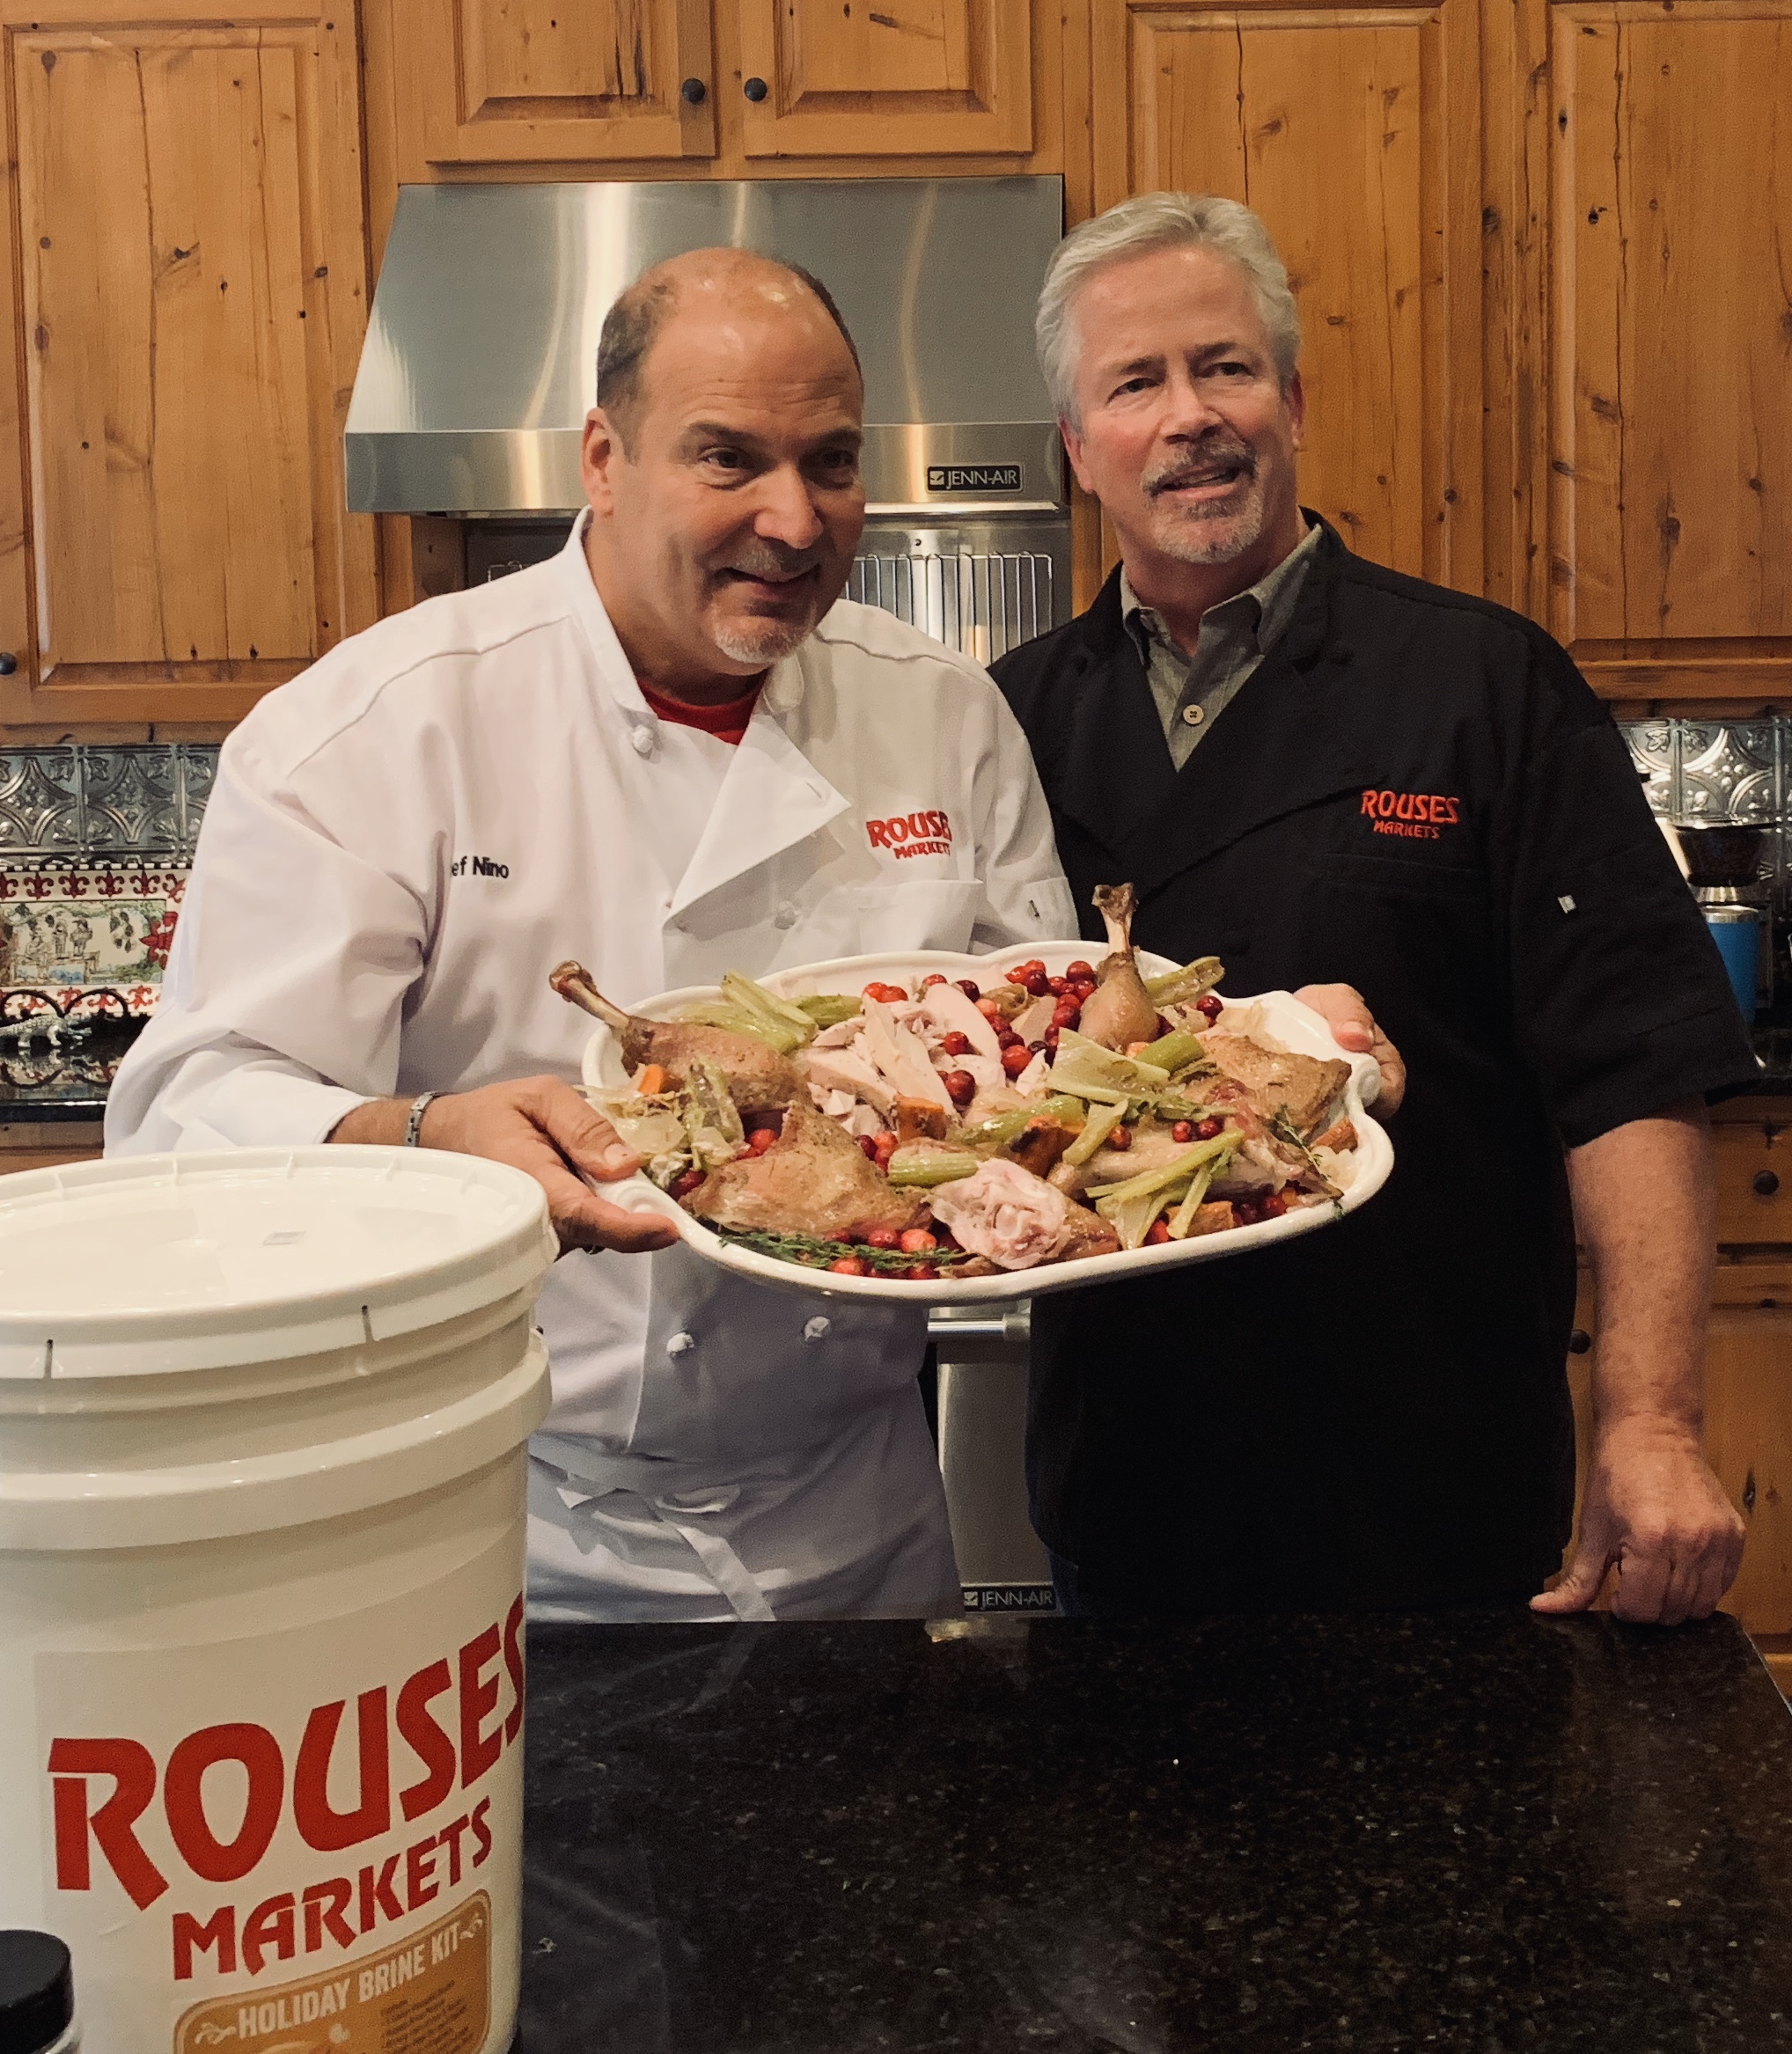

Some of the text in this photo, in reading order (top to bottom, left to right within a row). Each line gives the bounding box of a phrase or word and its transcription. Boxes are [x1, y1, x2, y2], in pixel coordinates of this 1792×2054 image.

[946, 469, 1017, 489] JENN-AIR
[1361, 789, 1460, 824] ROUSES
[866, 810, 952, 848] ROUSE
[1374, 819, 1441, 840] MARKETS
[893, 841, 951, 860] MARKET
[450, 855, 510, 879] ef Nino
[979, 1590, 1053, 1610] JENN-AIR
[48, 1590, 525, 1911] ROUSES
[173, 1795, 492, 1981] MARKETS
[238, 1978, 351, 2040] HOLIDAY
[358, 1945, 426, 2003] BRINE
[431, 1922, 460, 1965] KIT
